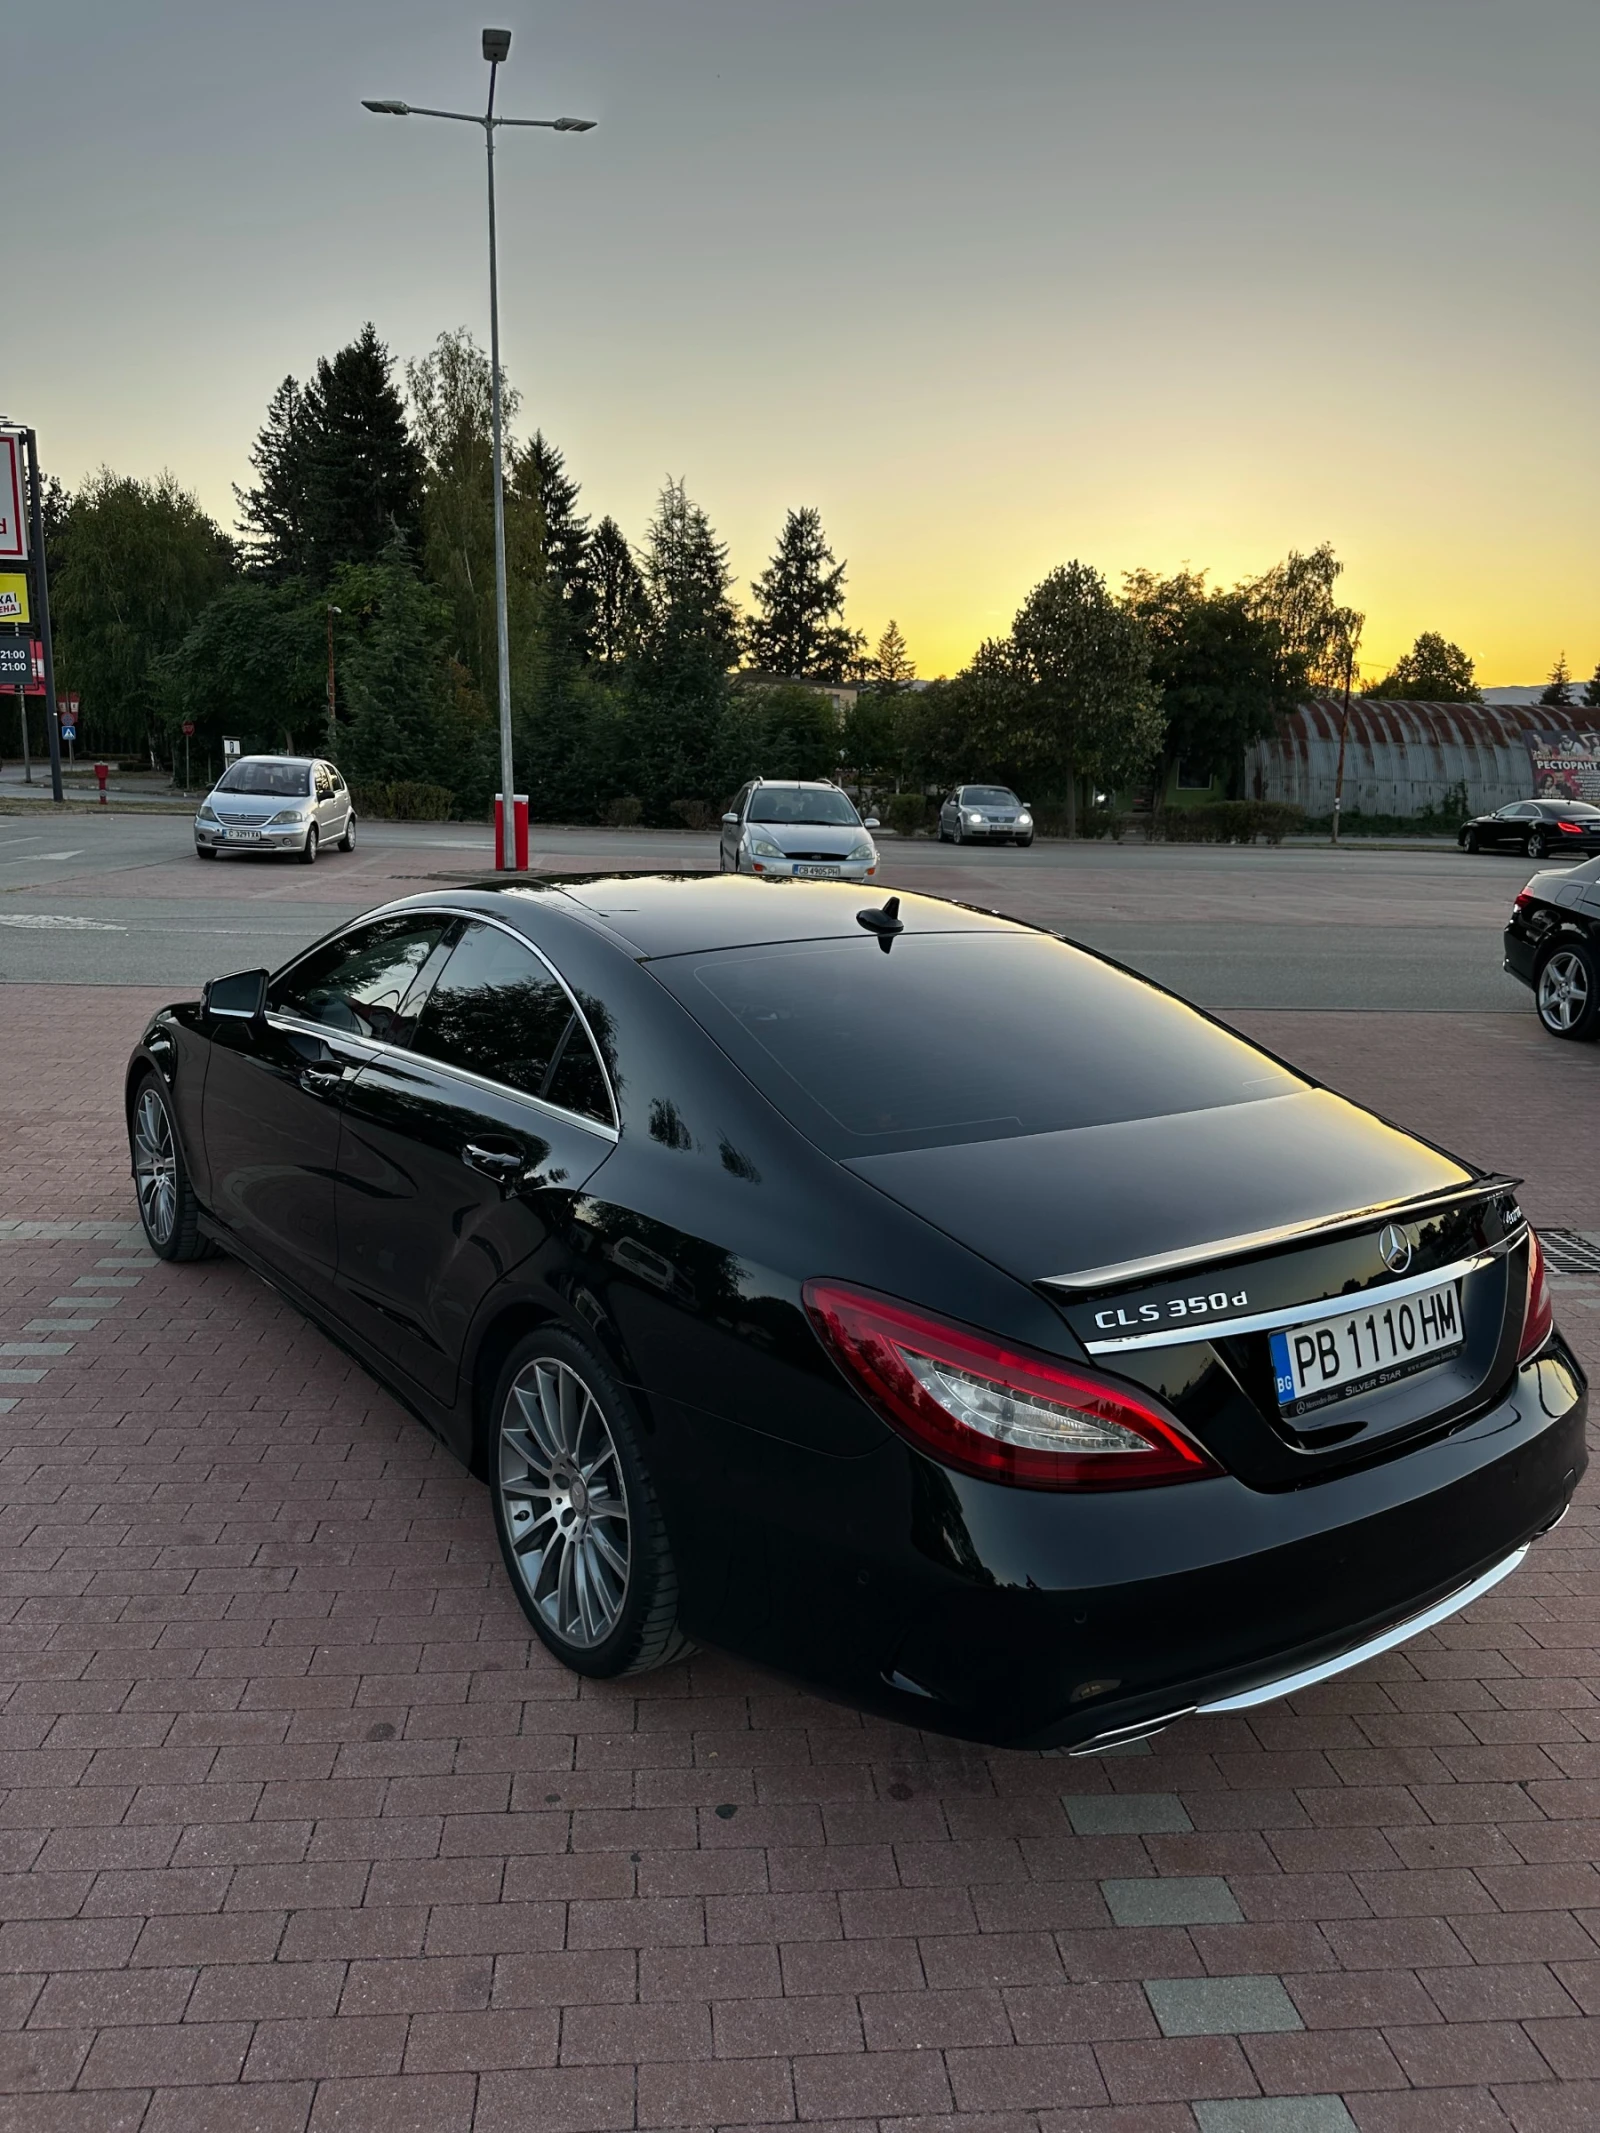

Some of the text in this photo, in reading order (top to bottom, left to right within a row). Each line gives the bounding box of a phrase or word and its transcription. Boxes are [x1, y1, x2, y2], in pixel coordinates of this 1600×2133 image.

[0, 650, 25, 659] 21:00
[1537, 761, 1597, 770] РЕСТОРАНТ
[1095, 1304, 1160, 1329] CLS
[1294, 1289, 1457, 1389] PB 1110 HM
[1277, 1375, 1293, 1393] BG
